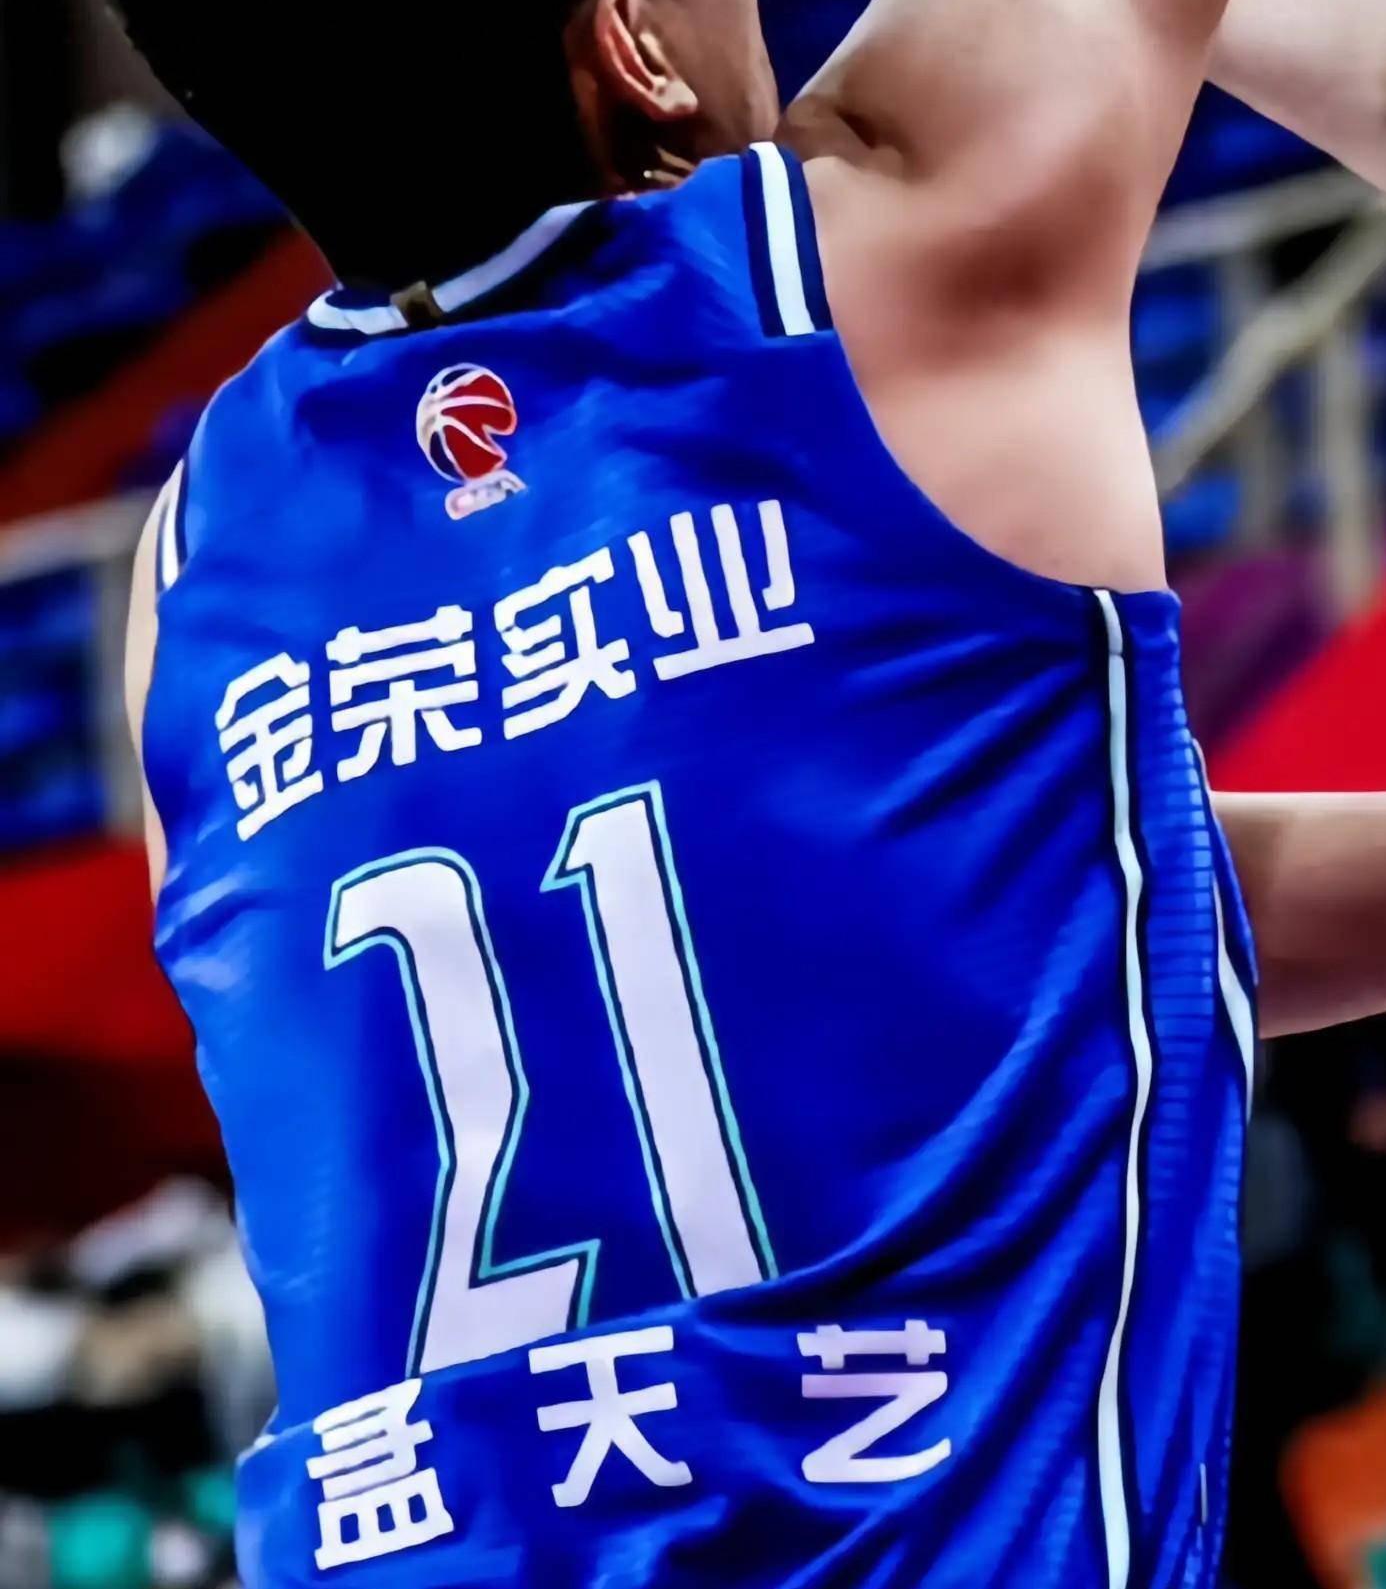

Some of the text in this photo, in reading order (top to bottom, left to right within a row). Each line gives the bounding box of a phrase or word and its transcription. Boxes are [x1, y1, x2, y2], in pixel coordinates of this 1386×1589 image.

[214, 499, 815, 842] 金荣实业
[323, 778, 778, 1380] 21
[305, 1318, 952, 1571] 孟天艺
